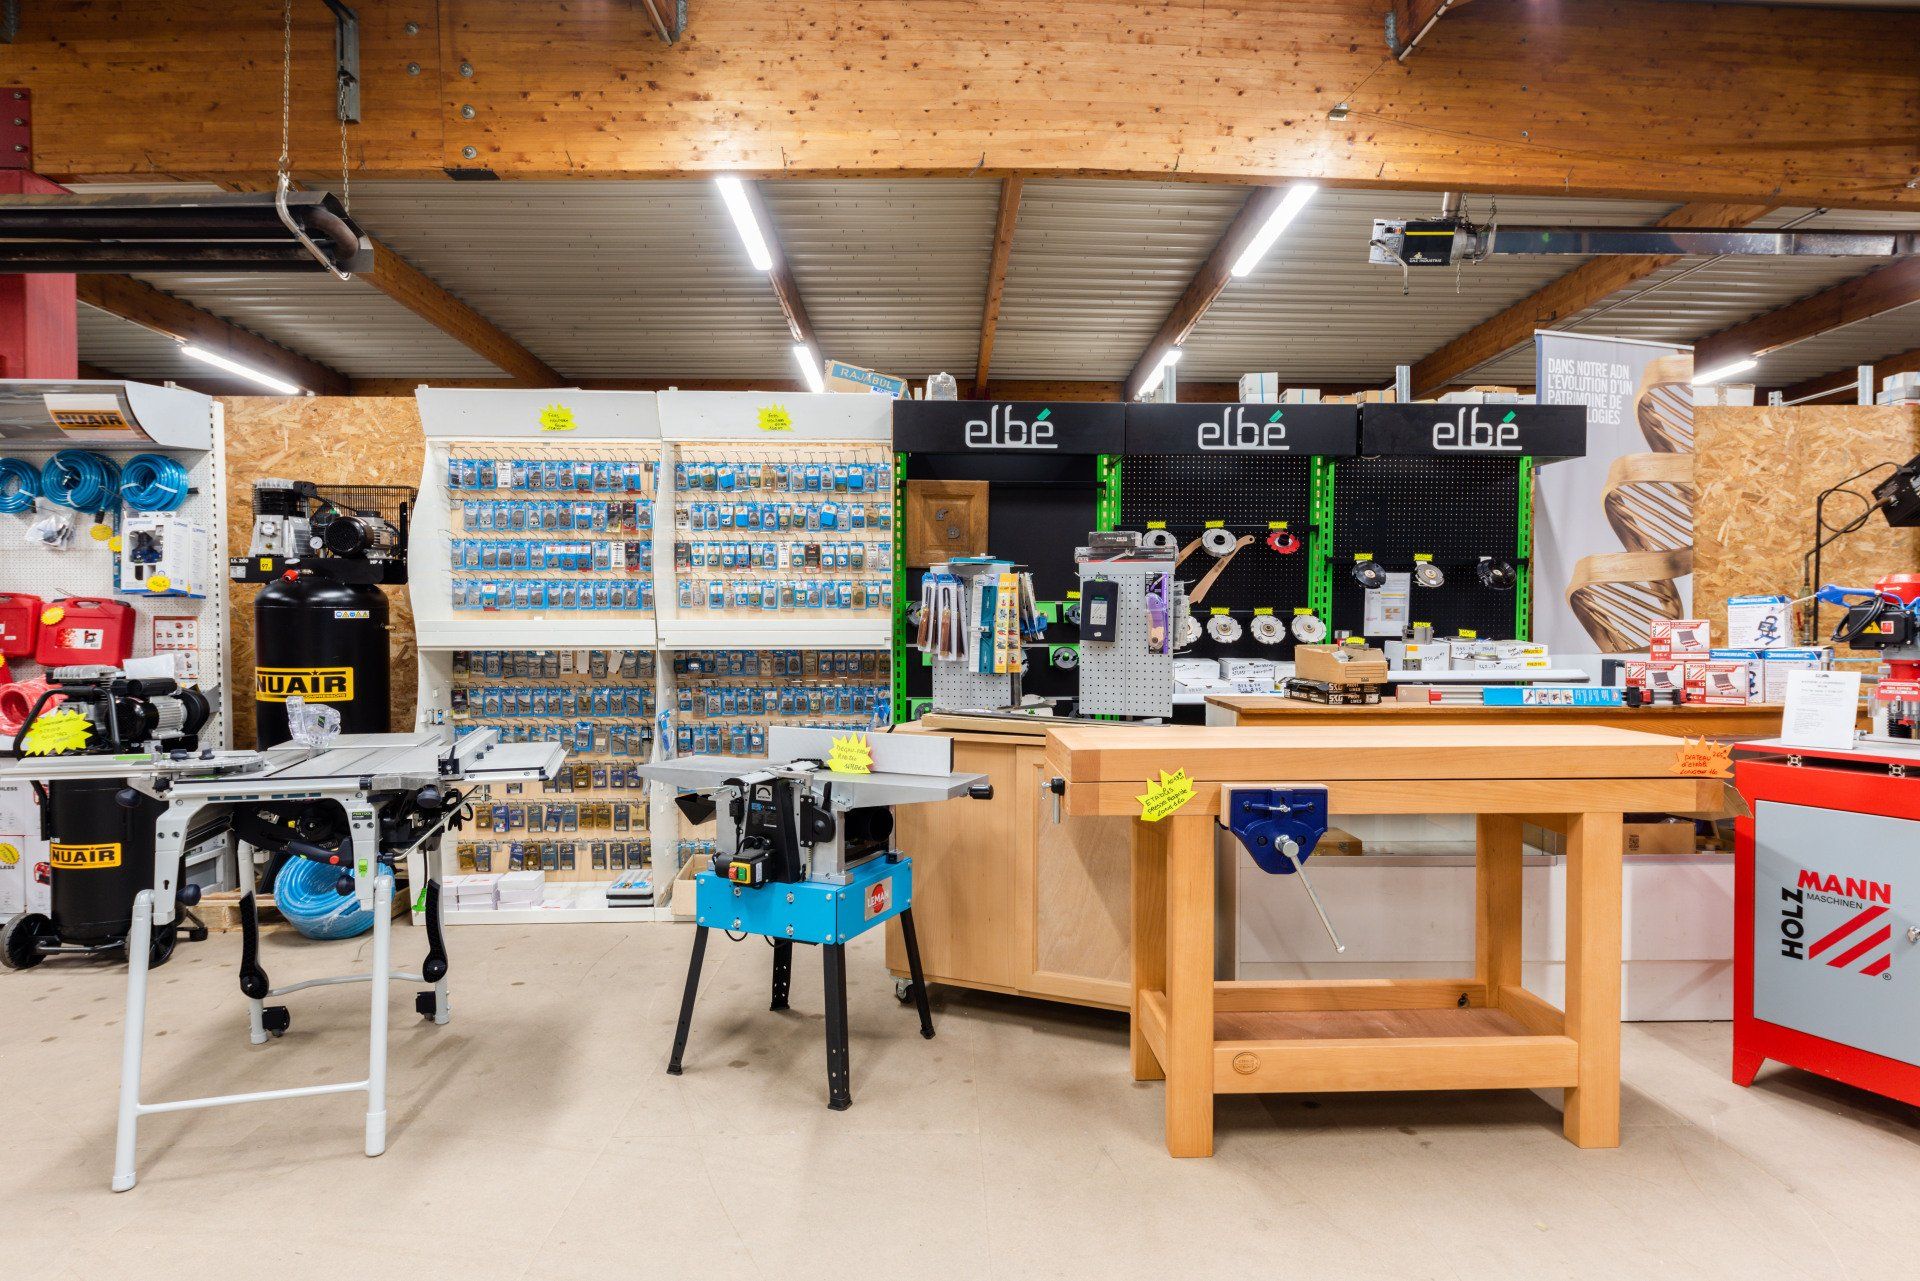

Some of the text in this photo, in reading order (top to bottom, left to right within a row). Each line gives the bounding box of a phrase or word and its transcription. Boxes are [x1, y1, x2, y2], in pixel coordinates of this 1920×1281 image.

[1548, 358, 1630, 380] DANS NOTRE ADN
[1610, 379, 1633, 396] D'UN
[1548, 390, 1622, 410] PATRIMOINE DE
[54, 411, 124, 427] NUAIR
[965, 404, 1059, 449] elbé
[1197, 406, 1290, 451] elbé
[1432, 406, 1523, 451] elbé
[256, 670, 347, 693] NUAIR
[52, 847, 115, 863] NUAIR
[1797, 869, 1891, 905] MANN
[867, 890, 889, 909] LEMAN
[1806, 892, 1863, 910] MASCHINEN
[1781, 886, 1804, 960] HOLZ
